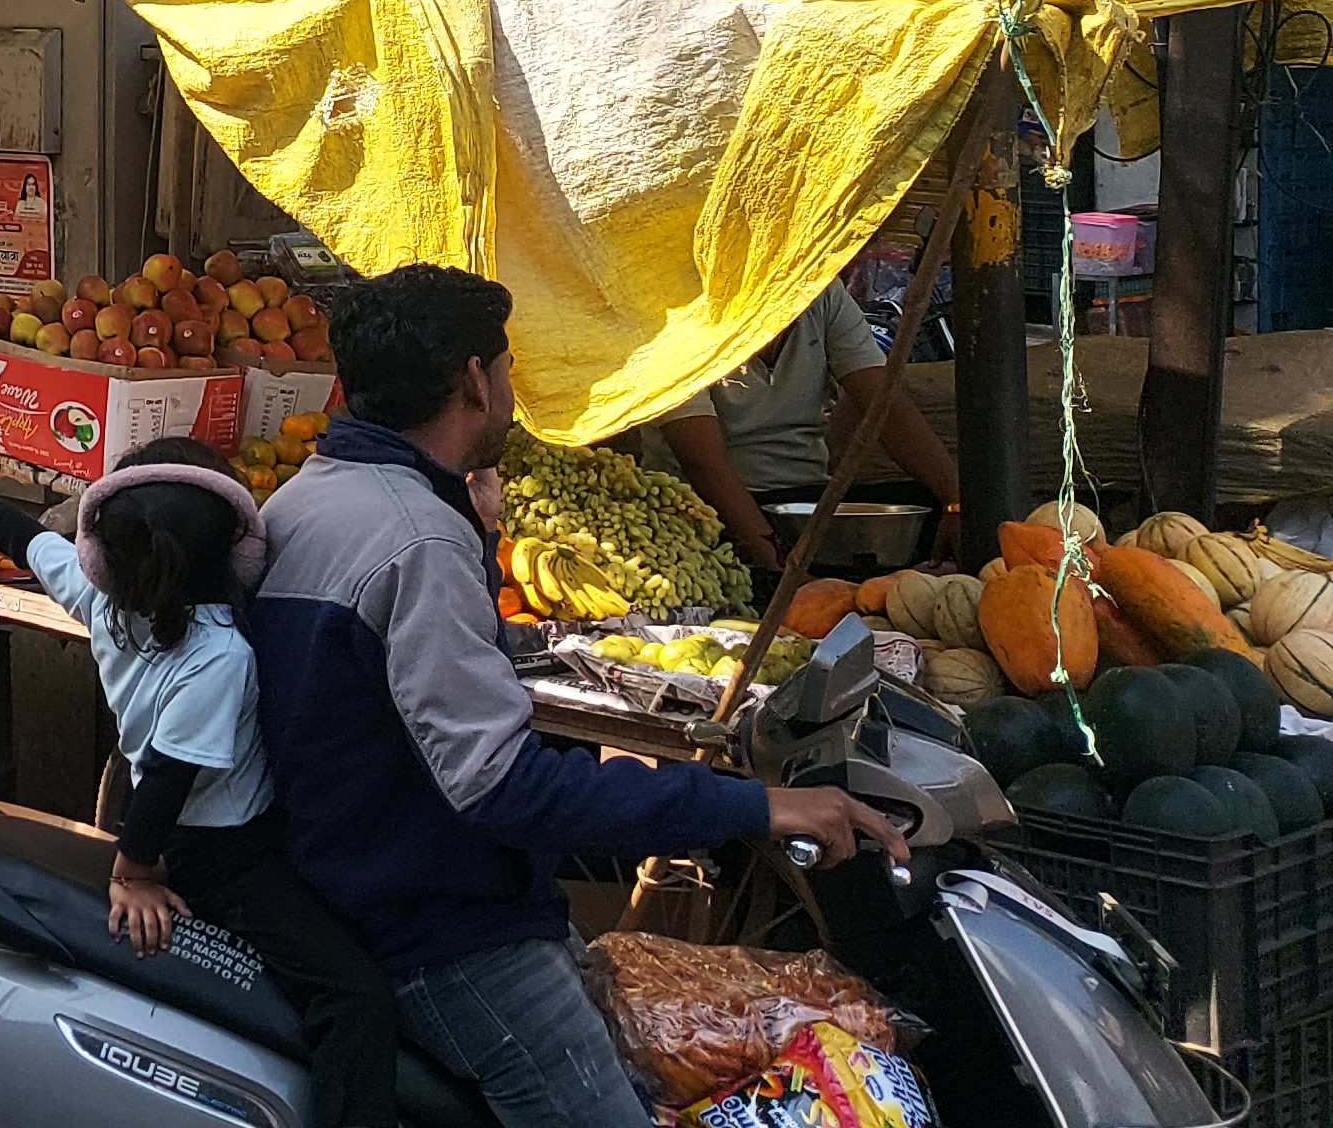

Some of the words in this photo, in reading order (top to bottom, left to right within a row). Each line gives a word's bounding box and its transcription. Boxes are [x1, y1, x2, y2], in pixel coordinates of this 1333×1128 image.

[0, 383, 40, 409] Wave
[192, 942, 234, 968] NAGAR
[234, 962, 255, 981] BPL
[209, 939, 265, 974] COMPLEX
[860, 1043, 919, 1128] School
